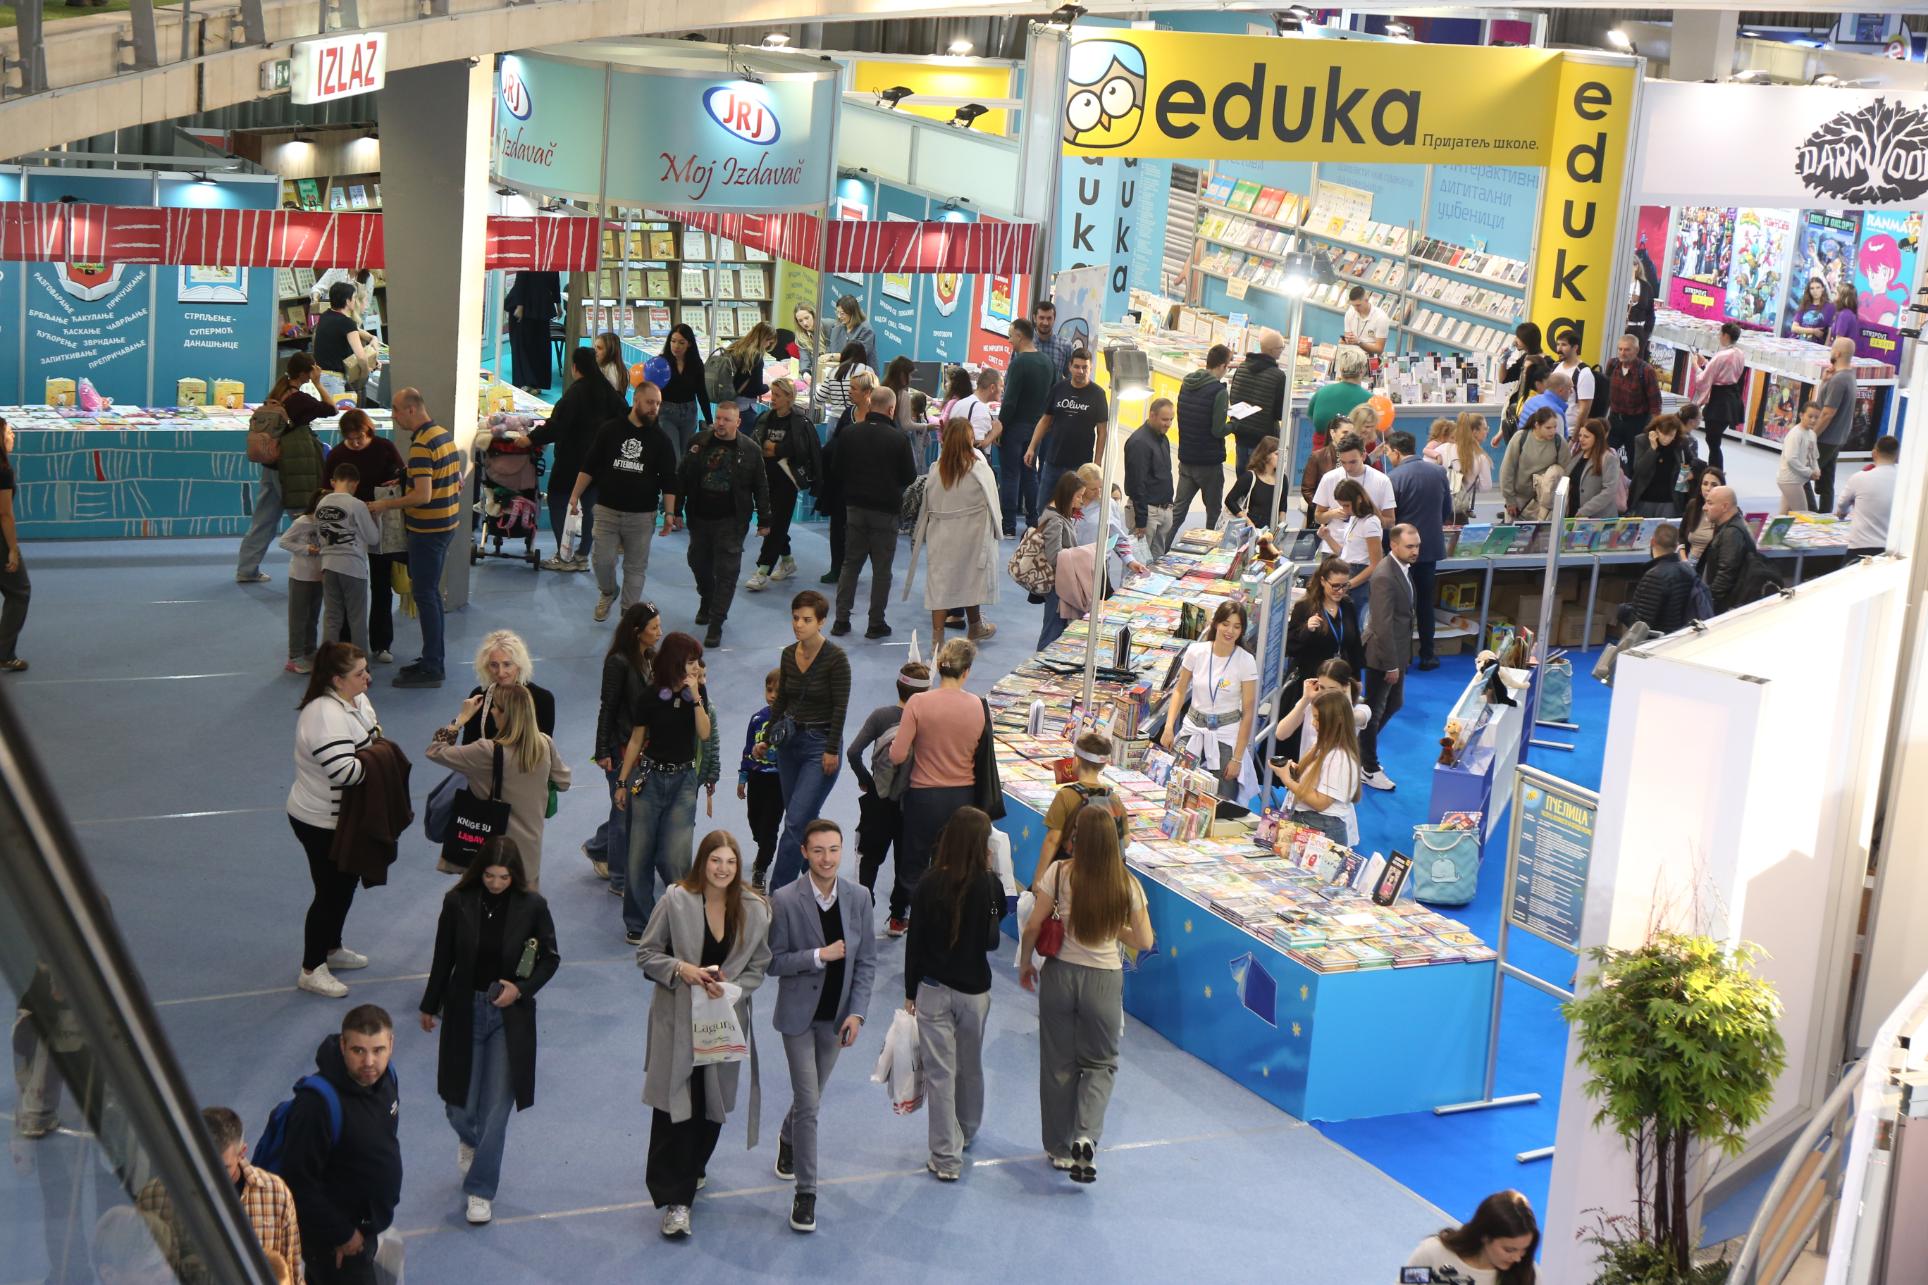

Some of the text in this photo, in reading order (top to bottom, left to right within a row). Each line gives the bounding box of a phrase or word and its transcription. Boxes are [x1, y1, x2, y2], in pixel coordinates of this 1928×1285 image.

[318, 40, 378, 97] IZLAZ
[722, 93, 764, 139] JRJ
[1155, 62, 1422, 147] eduka
[501, 126, 558, 167] Izdavač
[1421, 133, 1540, 151] Пријатељ школе.
[660, 151, 805, 201] Moj Izdavač
[1440, 179, 1513, 207] дигитални
[33, 272, 76, 314] РАЗГОВАРАЊЕ
[28, 309, 70, 325] БРБЉАЊЕ
[106, 307, 149, 331] ЧАВРЉАЊЕ
[184, 312, 232, 324] СТРПЉЕЊЕ
[63, 327, 101, 336] ЋАСКАЊЕ
[189, 326, 234, 336] СУПЕРМОЋ
[41, 349, 98, 365] ЗАПИТКИВАЊЕ
[88, 339, 147, 369] ПРЕПРИЧАВАЊЕ
[184, 339, 239, 350] ДАНАШЊИЦЕ
[1545, 795, 1589, 827] ПЧЕЛИЦА
[481, 823, 492, 833] SU
